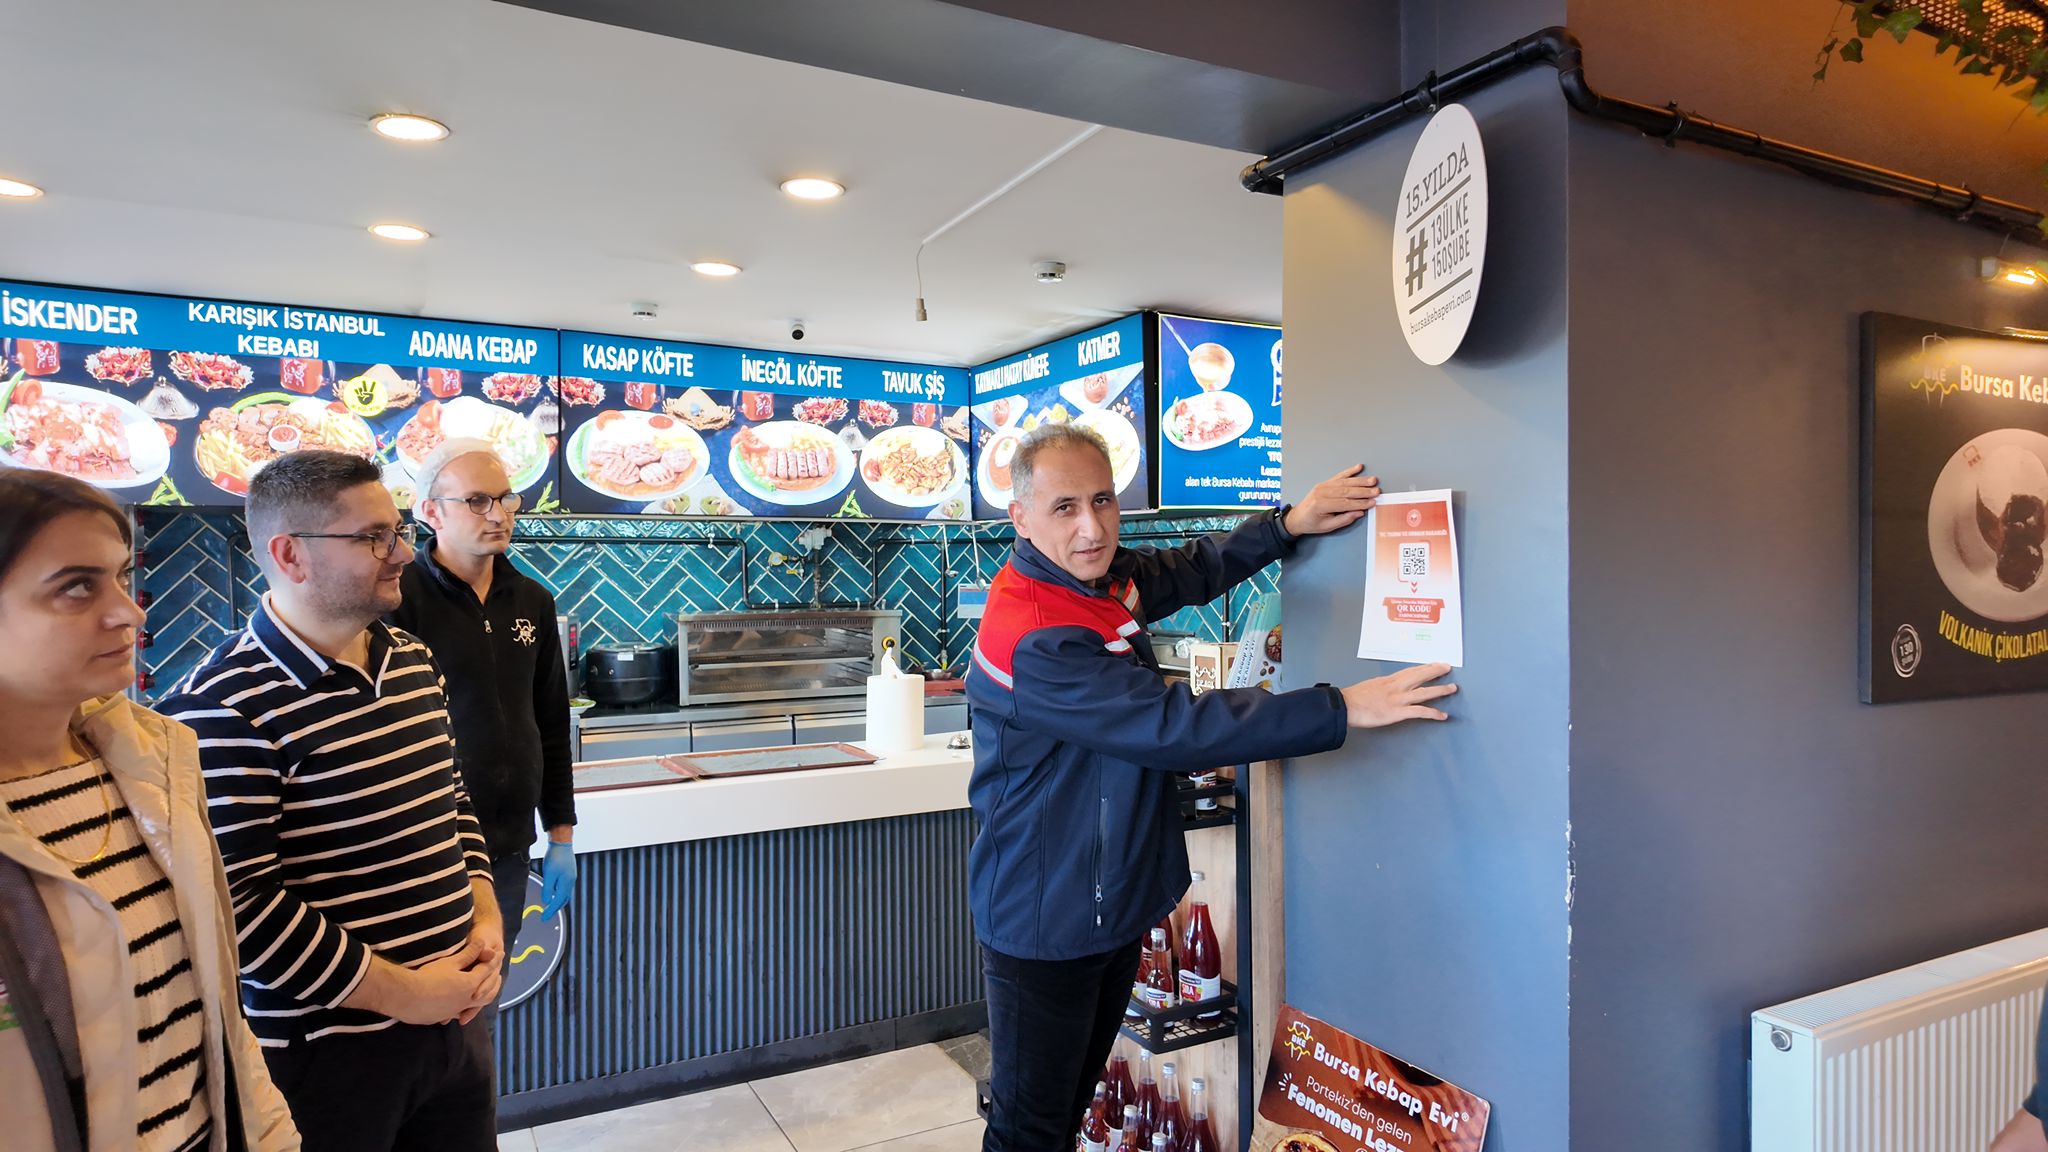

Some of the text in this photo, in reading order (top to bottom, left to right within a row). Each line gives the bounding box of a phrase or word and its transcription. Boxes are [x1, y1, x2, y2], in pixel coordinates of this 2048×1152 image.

[1406, 142, 1470, 218] 15.YILDA
[2, 290, 139, 335] İSKENDER
[188, 302, 386, 337] KARIŞIK İSTANBUL
[1410, 288, 1472, 335] bursakebapevi.com
[237, 334, 319, 359] KEBABI
[408, 330, 538, 365] ADANA KEBAP
[583, 343, 694, 378] KASAP KÖFTE
[1077, 331, 1121, 367] KATMER
[741, 353, 843, 389] İNEGÖL KÖFTE
[882, 369, 945, 401] TAVUK ŞİŞ
[1960, 364, 2014, 399] Bursa
[1396, 604, 1432, 614] QR KODU
[1938, 609, 1993, 657] VOLKANİK
[1291, 1033, 1307, 1048] BKE
[1313, 1041, 1361, 1081] Bursa
[1364, 1068, 1424, 1117] Kebap
[1287, 1083, 1363, 1141] Fenomen
[1306, 1075, 1412, 1145] Portekiz'den gelen
